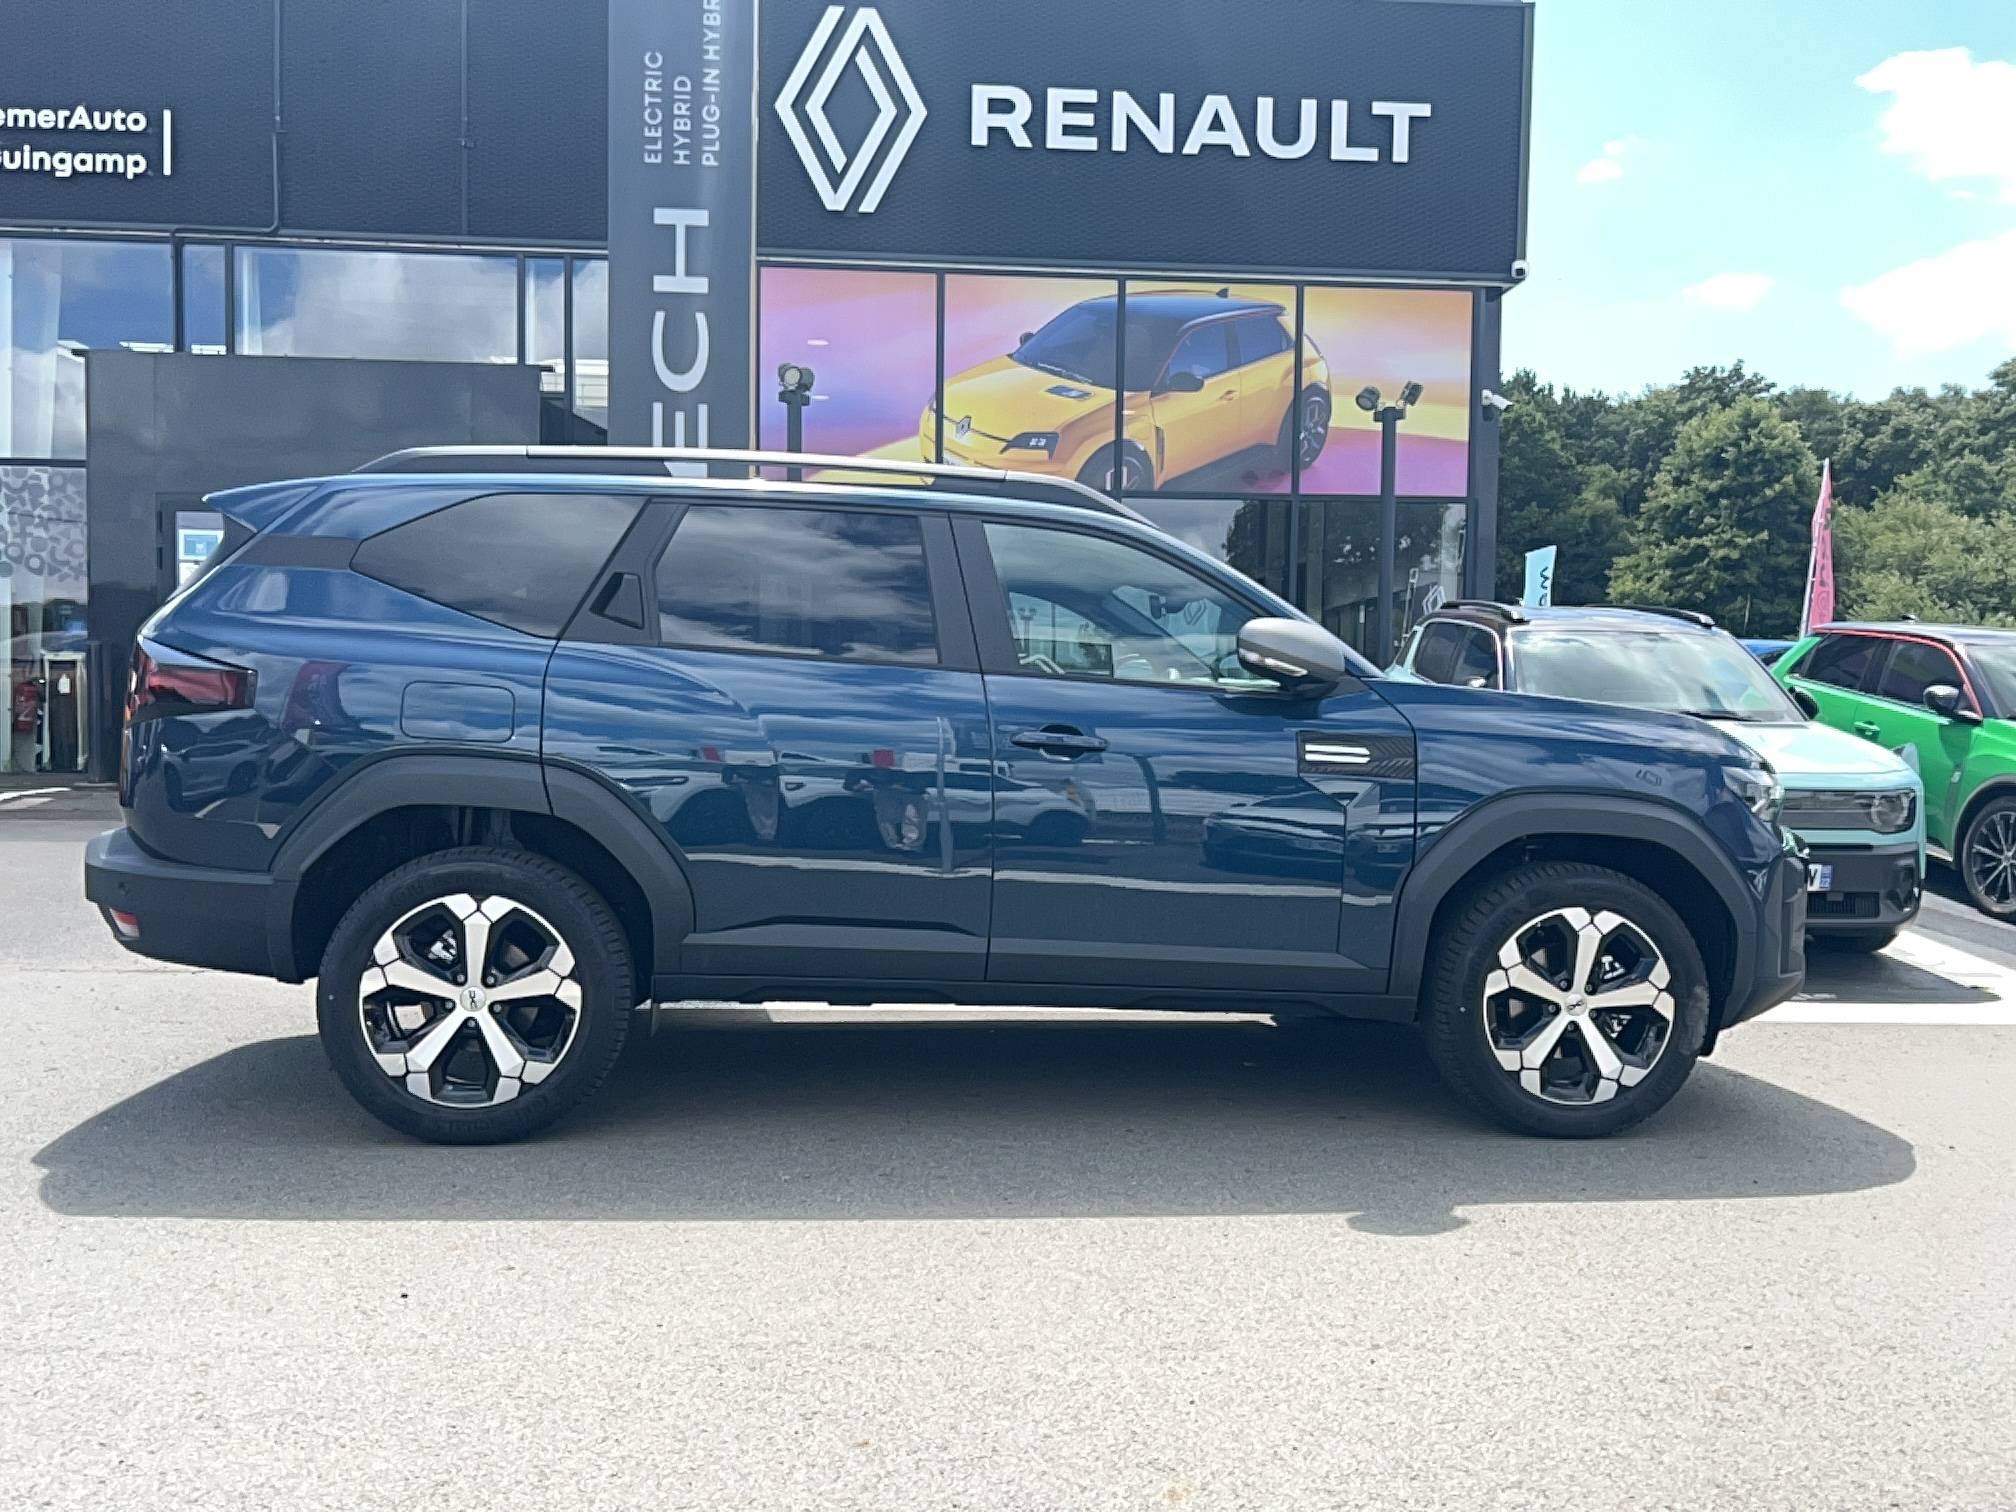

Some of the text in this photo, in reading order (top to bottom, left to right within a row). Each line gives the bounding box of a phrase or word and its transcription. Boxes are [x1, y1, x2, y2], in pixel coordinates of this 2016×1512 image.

[0, 105, 148, 132] merAuto
[643, 51, 663, 164] ELECTRIC
[673, 75, 692, 165] HYBRID
[701, 67, 721, 166] PLUG-IN
[970, 83, 1432, 164] RENAULT
[0, 144, 148, 180] uingamp
